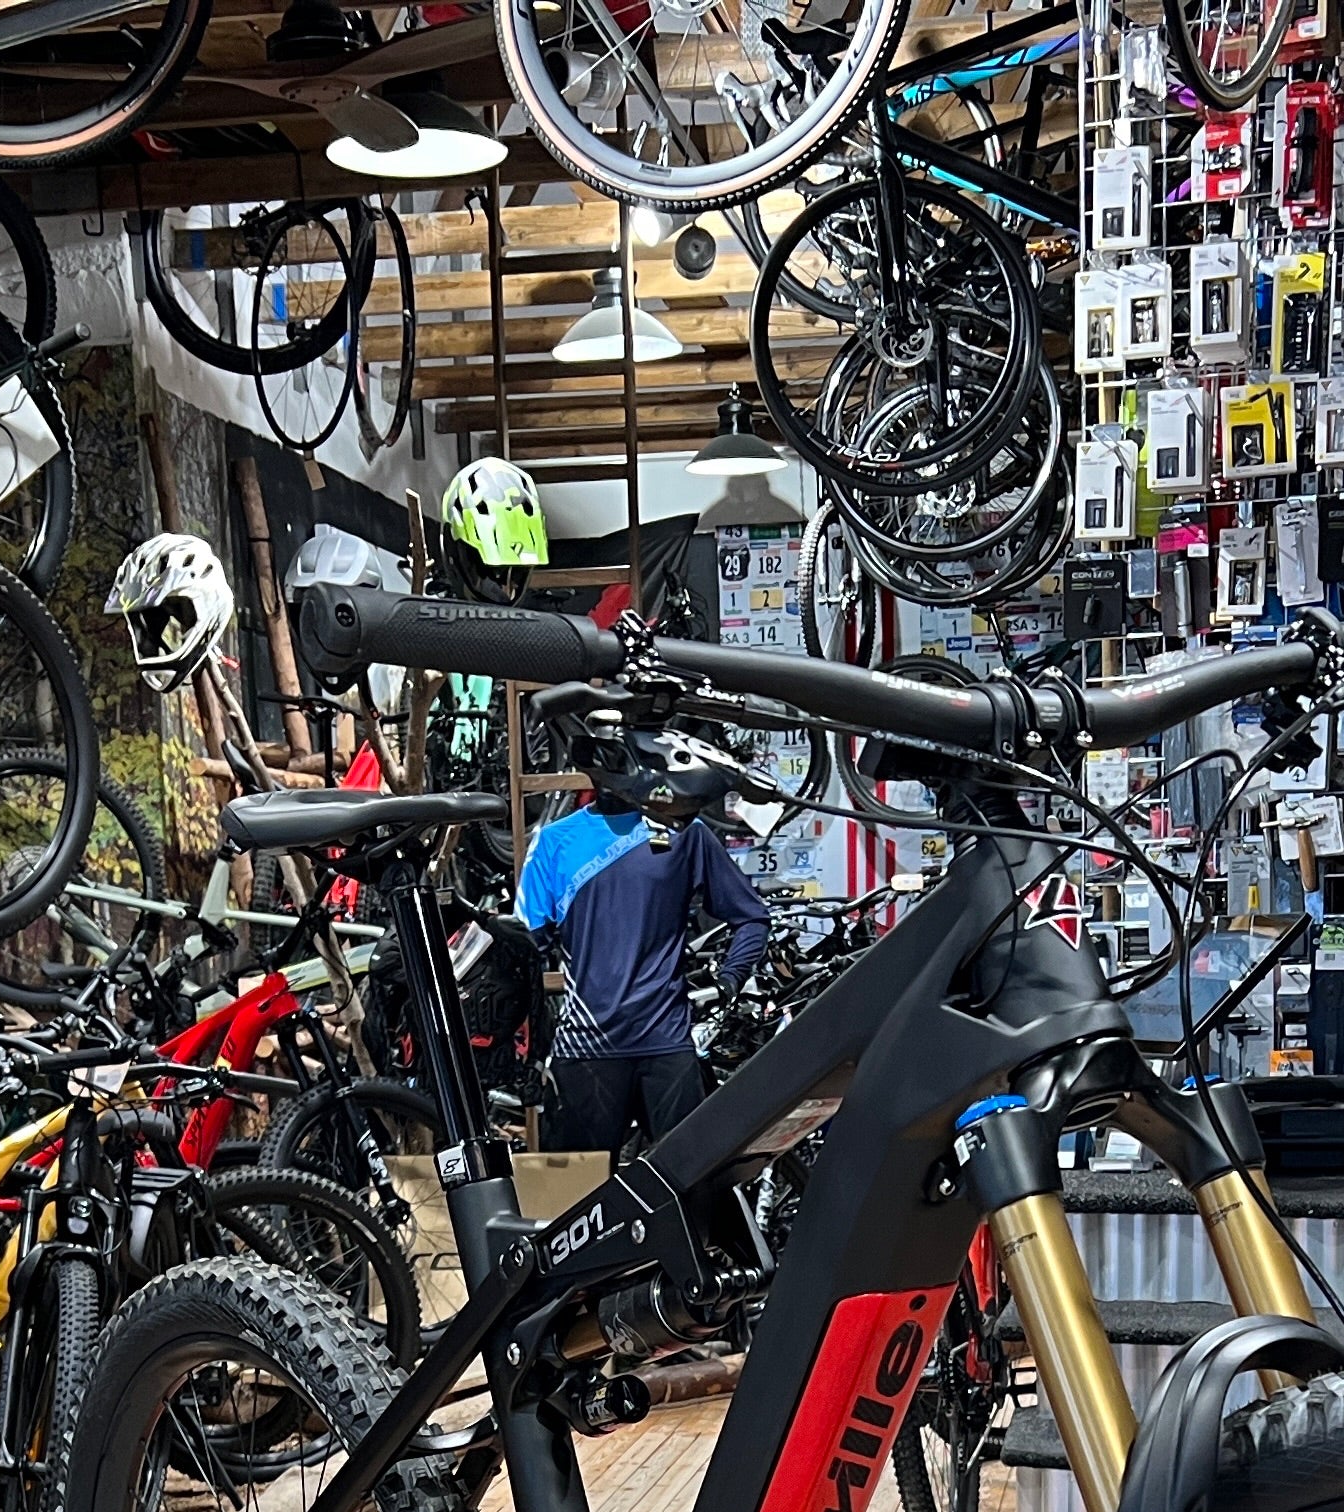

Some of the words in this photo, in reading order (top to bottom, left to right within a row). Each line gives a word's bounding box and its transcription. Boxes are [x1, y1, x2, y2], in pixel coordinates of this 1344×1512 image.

[724, 554, 741, 576] 29
[758, 556, 782, 574] 182
[763, 589, 770, 608] 2
[1031, 619, 1040, 631] 3
[757, 626, 777, 643] 14
[789, 758, 804, 775] 15
[921, 839, 938, 855] 62
[757, 853, 778, 872] 35
[549, 1202, 606, 1265] 301
